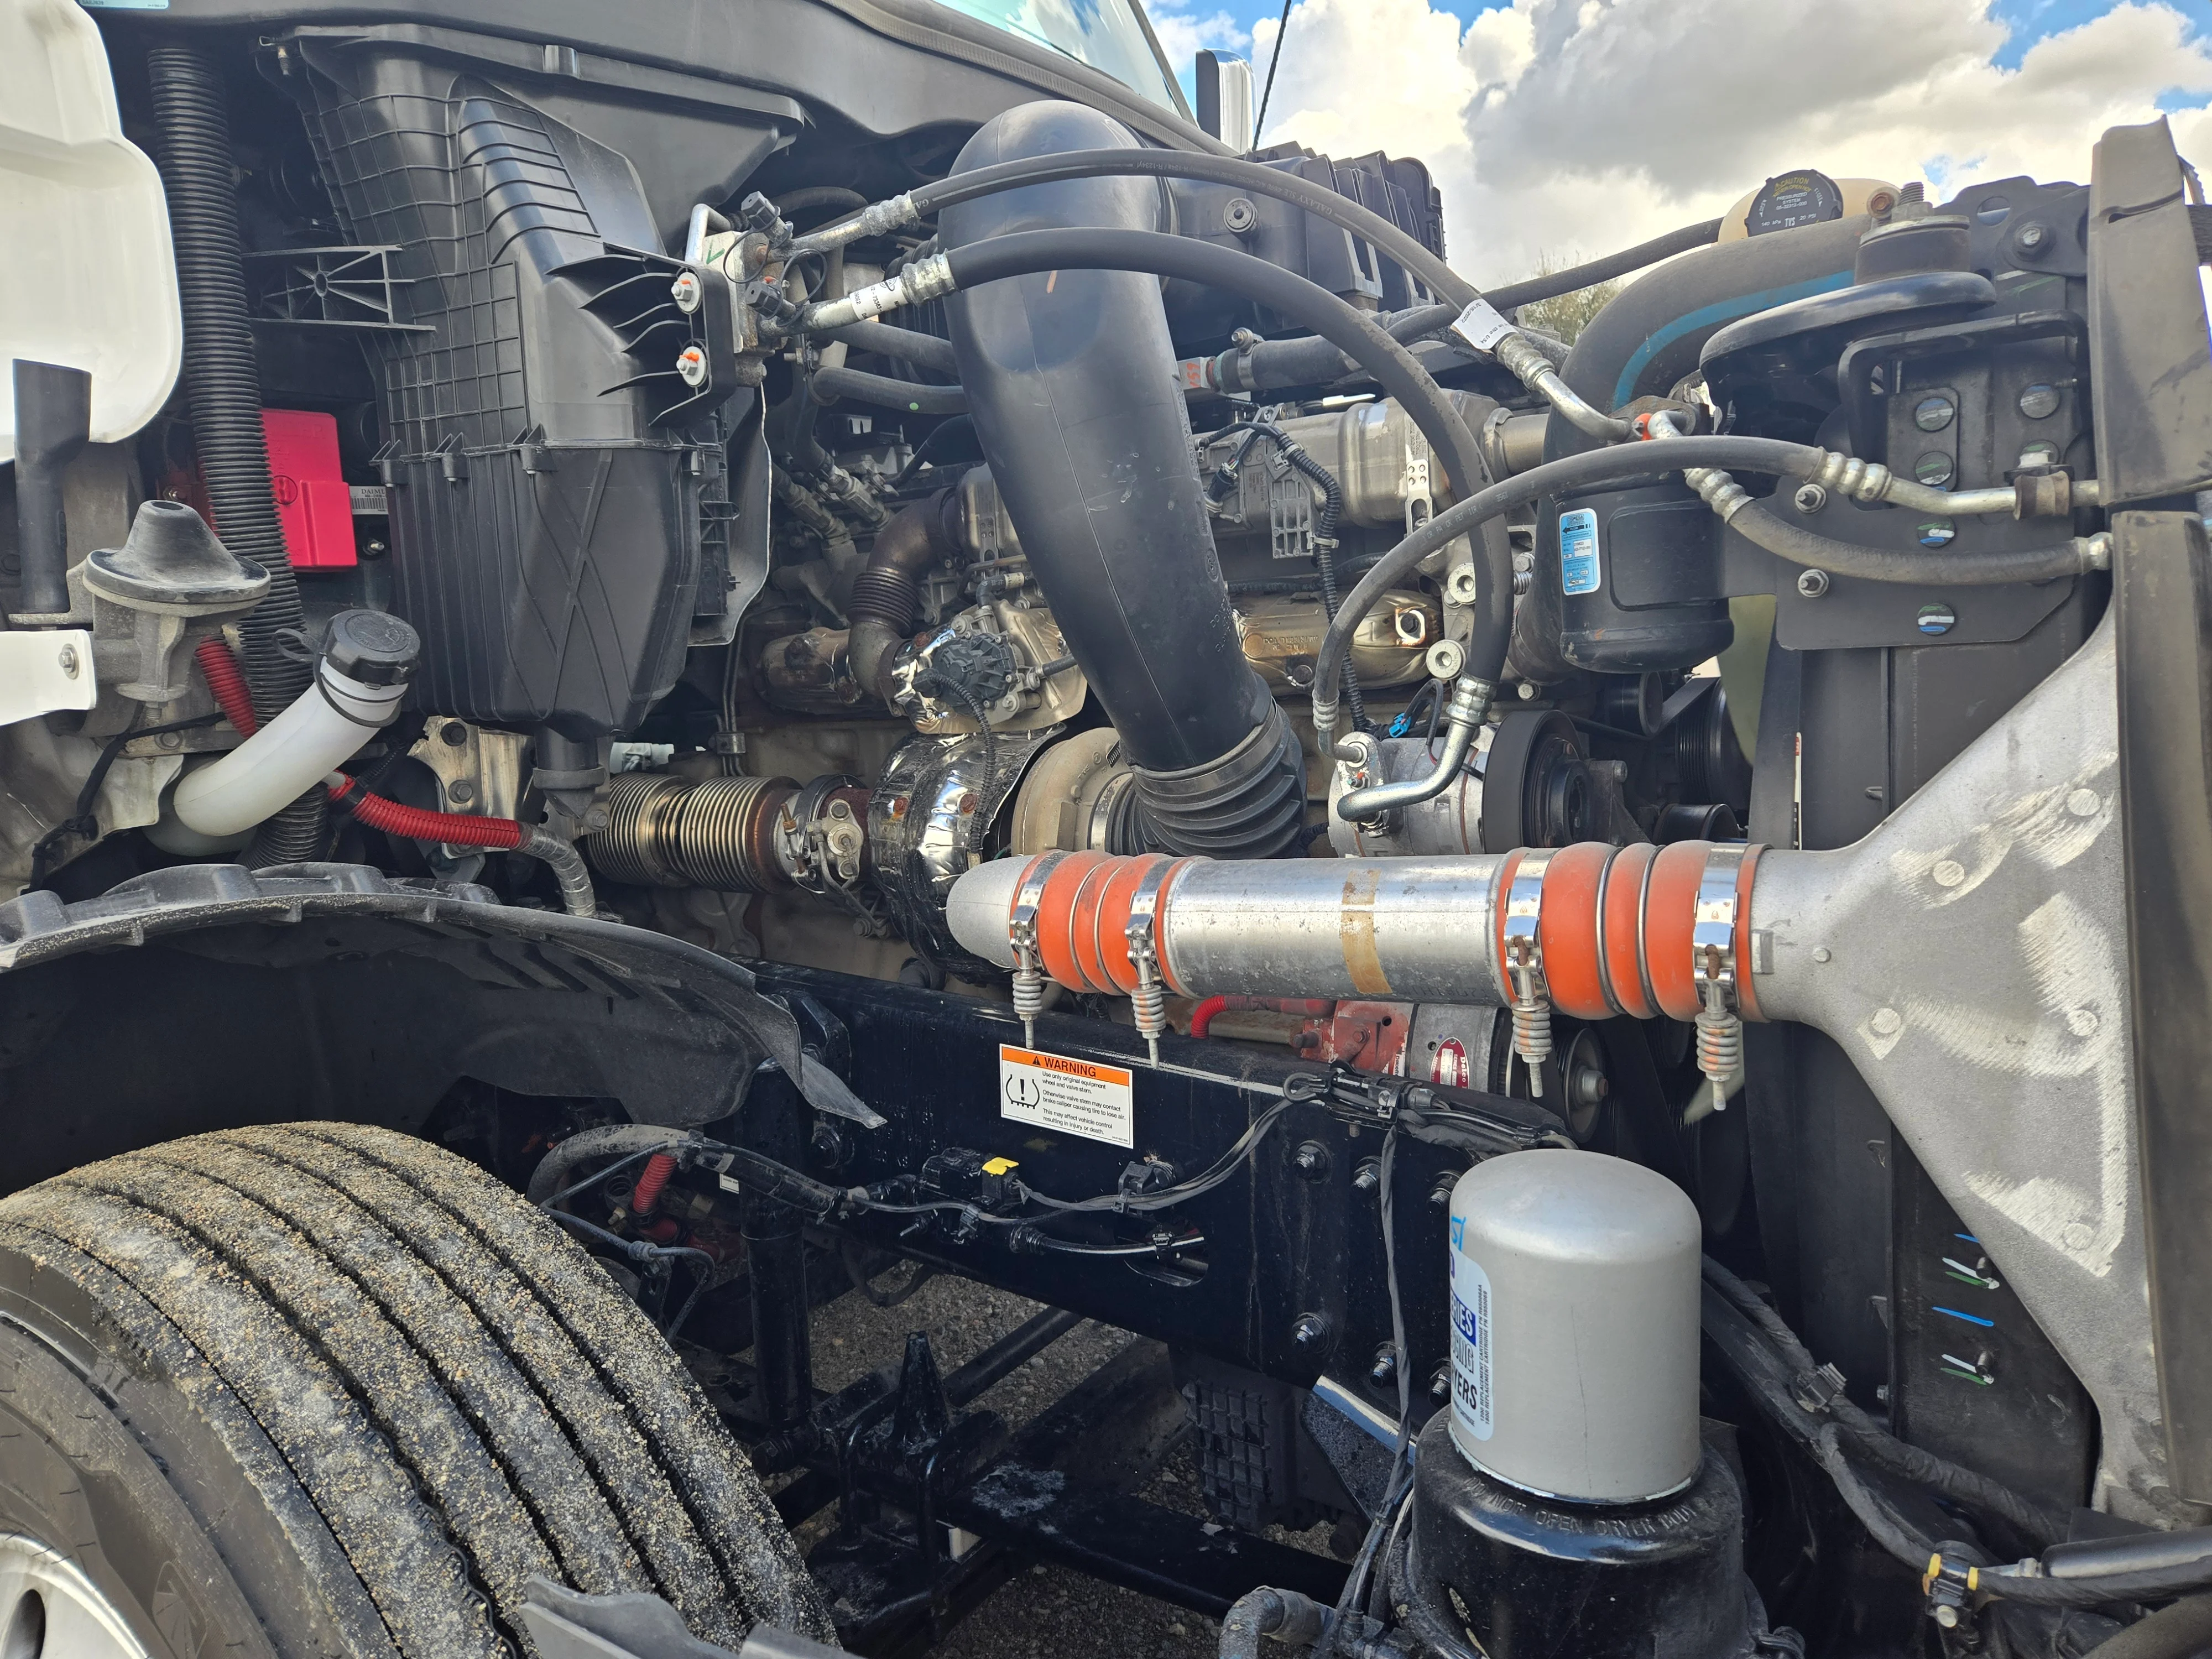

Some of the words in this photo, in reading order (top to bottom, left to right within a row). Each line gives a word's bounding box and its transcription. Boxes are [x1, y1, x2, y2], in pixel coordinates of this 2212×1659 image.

[1781, 177, 1809, 186] CAUTION
[1284, 188, 1296, 199] SLE
[1776, 191, 1807, 201] PRESSURIZED
[1297, 195, 1333, 215] GALAXY
[1785, 217, 1796, 227] TVS
[1460, 302, 1481, 324] 3/16/2022
[1489, 326, 1499, 335] the
[1479, 334, 1490, 345] USA
[1044, 1057, 1096, 1077] WARNING
[1063, 1076, 1080, 1084] original
[1081, 1079, 1106, 1089] equipment
[1042, 1089, 1065, 1099] Otherwise
[1103, 1103, 1121, 1112] contact
[1056, 1099, 1072, 1108] caliper
[1072, 1103, 1091, 1113] causing
[1042, 1116, 1063, 1126] resulting
[1069, 1121, 1083, 1130] injury
[1078, 1117, 1095, 1125] vehicle
[1095, 1120, 1113, 1129] control
[1450, 1293, 1473, 1337] ERIES
[1478, 1316, 1483, 1326] PN
[1483, 1318, 1489, 1328] PN
[1463, 1477, 1487, 1498] DO
[1489, 1493, 1527, 1515] NOT
[1535, 1508, 1585, 1534] OPEN
[1594, 1517, 1656, 1538] DRYER
